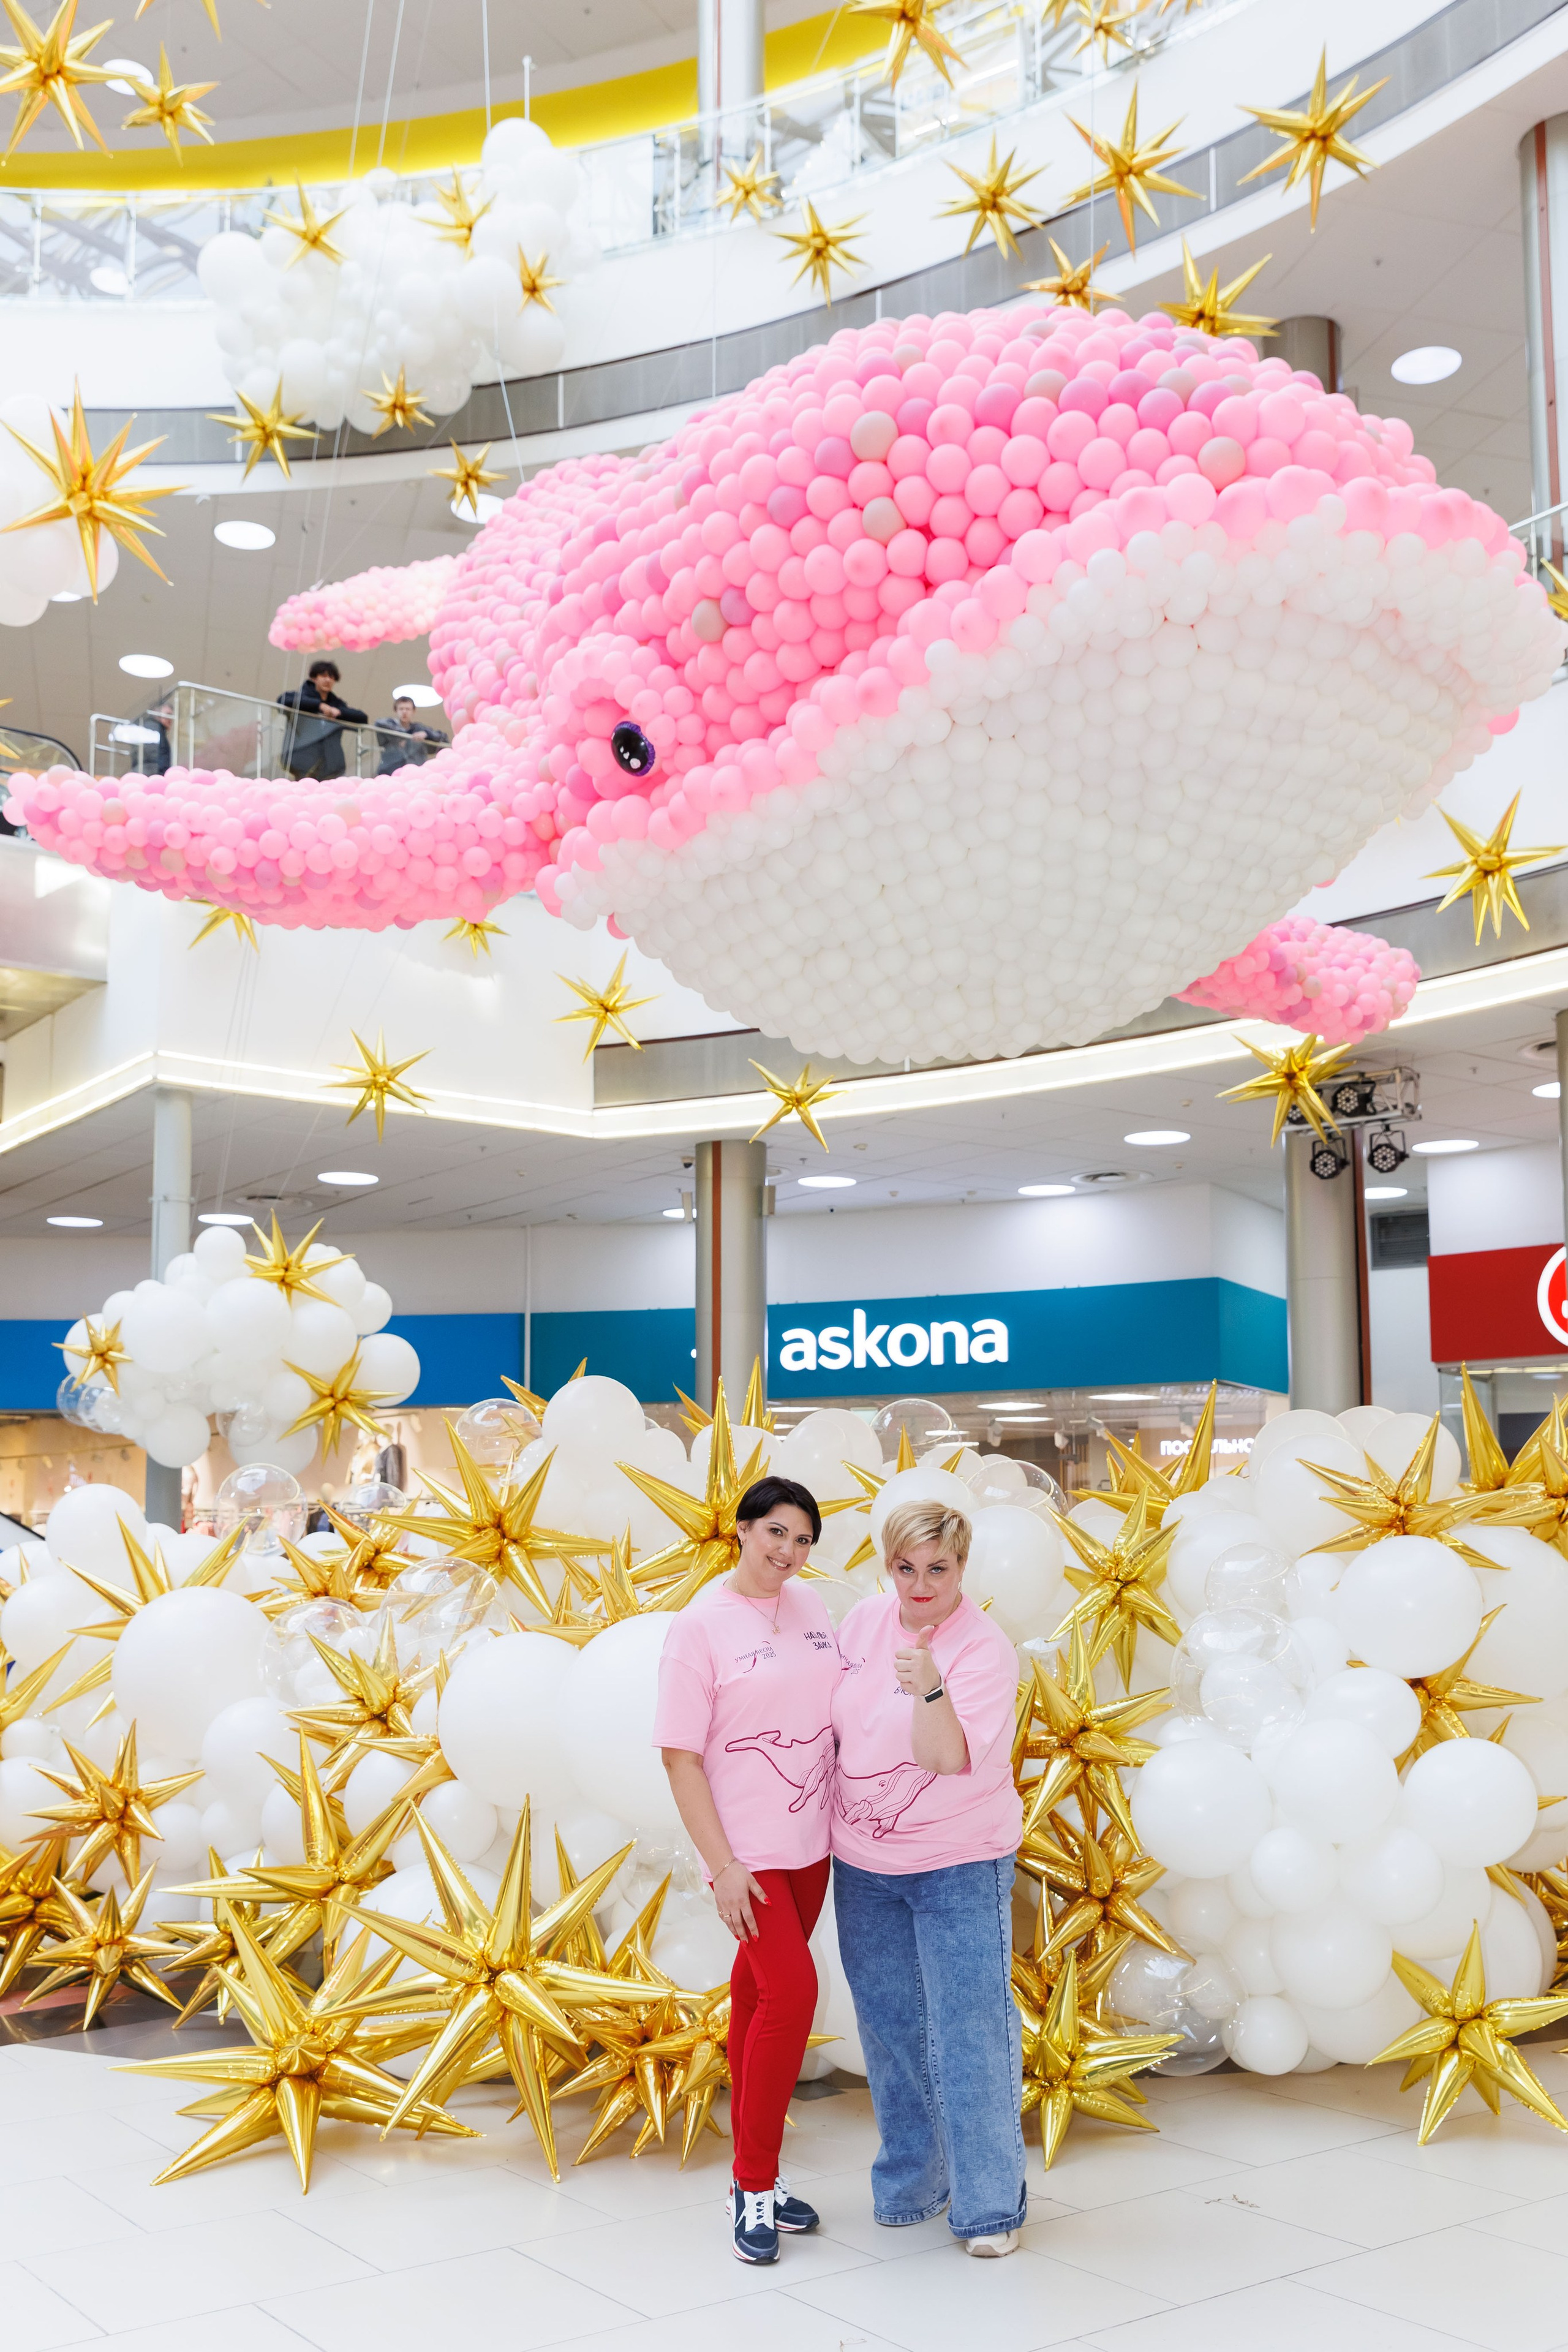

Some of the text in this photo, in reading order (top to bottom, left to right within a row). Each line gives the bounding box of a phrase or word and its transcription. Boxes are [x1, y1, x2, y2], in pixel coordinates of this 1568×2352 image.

[779, 1308, 1009, 1371] askona
[1160, 1438, 1255, 1456] ПОСЛЬНО
[734, 1651, 755, 1663] УМНАЯ
